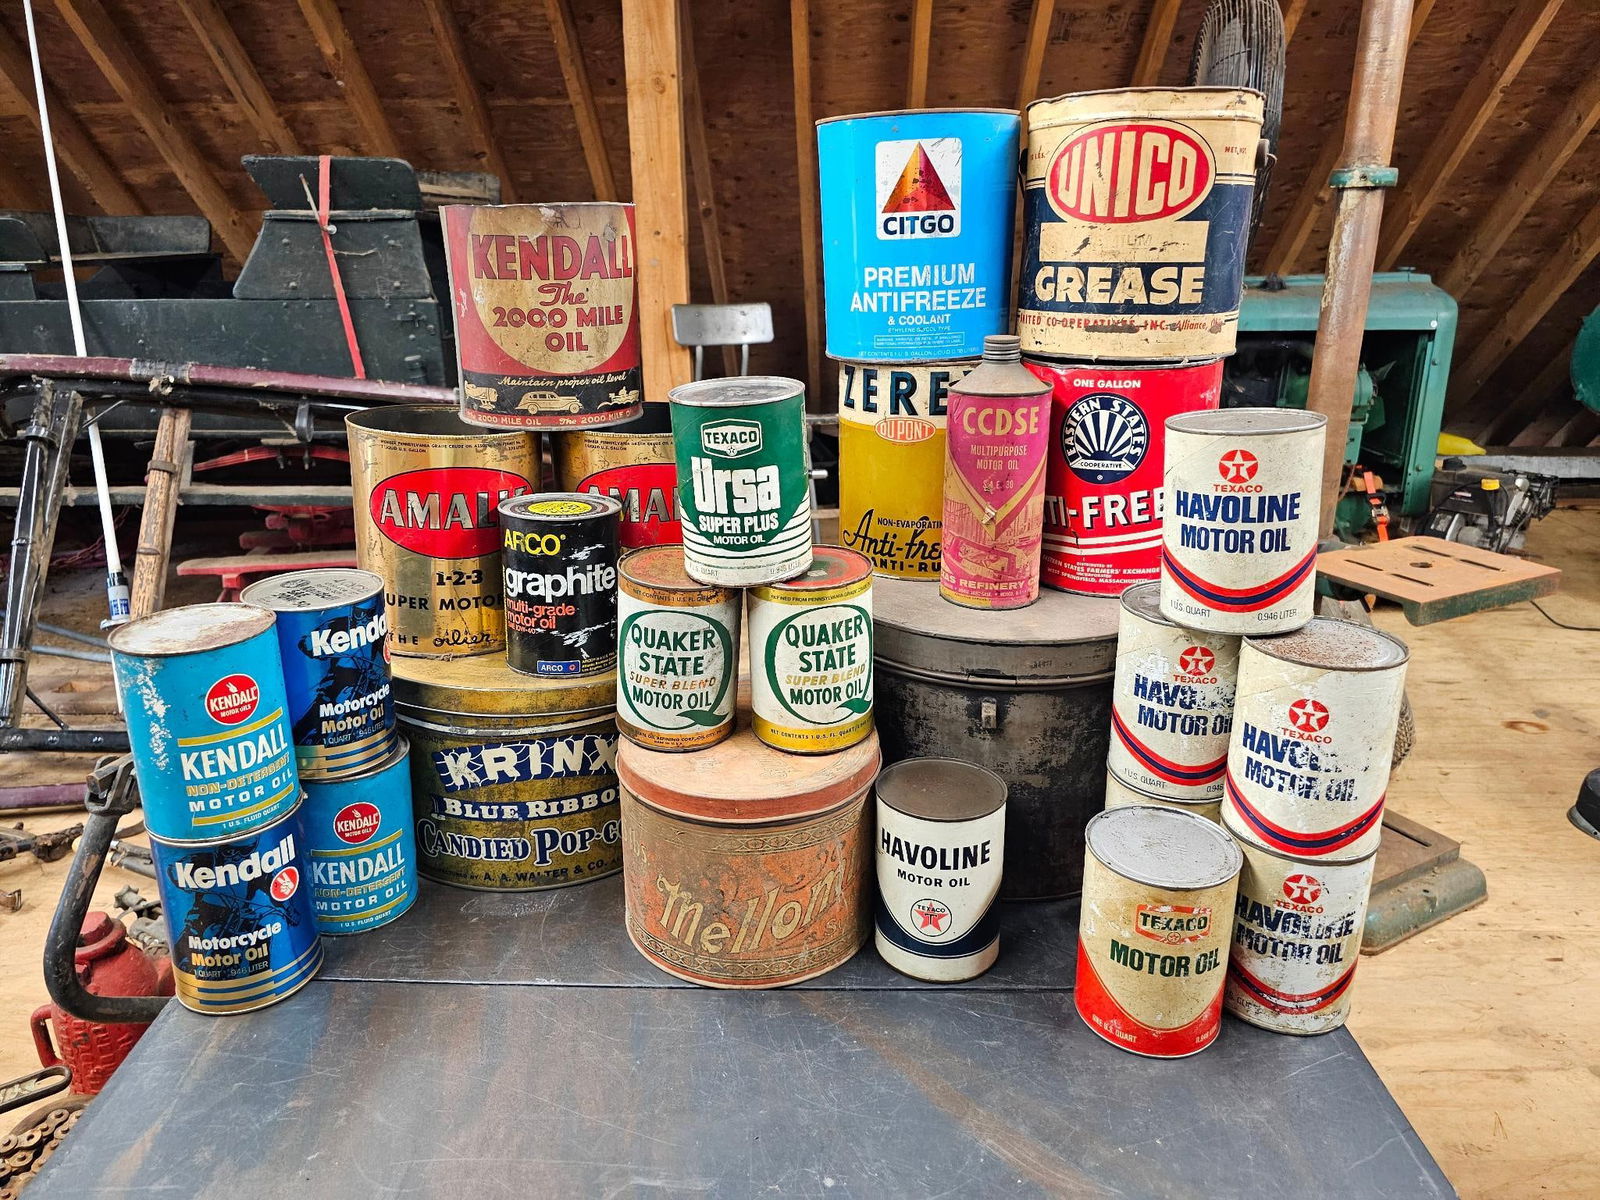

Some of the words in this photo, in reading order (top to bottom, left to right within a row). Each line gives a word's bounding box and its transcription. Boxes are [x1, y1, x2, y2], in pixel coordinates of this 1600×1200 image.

[1057, 131, 1198, 218] UNICO
[883, 214, 954, 236] CITGO
[471, 235, 633, 281] KENDALL
[864, 263, 975, 288] PREMIUM
[1034, 266, 1206, 305] GREASE
[538, 281, 588, 307] The
[850, 287, 986, 312] ANTIFREEZE
[493, 307, 568, 328] 2000
[577, 305, 623, 328] MILE
[888, 317, 896, 325] &
[898, 314, 951, 325] COOLANT
[545, 332, 589, 352] OIL
[498, 375, 556, 387] Maintain
[555, 377, 590, 389] proper
[591, 374, 605, 384] oil
[606, 371, 627, 383] level
[843, 365, 972, 416] ZERE
[1073, 379, 1094, 388] ONE
[1097, 379, 1141, 389] GALLON
[478, 414, 498, 424] 2000
[501, 416, 522, 426] MILE
[526, 417, 542, 426] OIL
[559, 417, 577, 426] The
[581, 414, 606, 425] 2000
[897, 420, 929, 440] PONT
[963, 406, 1039, 436] CCDSE
[1064, 397, 1101, 457] EASTERN
[1110, 399, 1145, 457] STATES
[705, 431, 757, 444] TEXACO
[970, 445, 1028, 457] MULTIPURPOSE
[976, 459, 1003, 470] MOTOR
[1008, 459, 1020, 470] OIL
[1080, 461, 1122, 469] COOPERATIVE
[691, 456, 781, 514] Ursa
[1213, 484, 1263, 493] TEXACO
[380, 484, 527, 530] AMAL
[1175, 490, 1301, 524] HAVOLINE
[698, 515, 740, 534] SUPER
[744, 512, 779, 533] PLUS
[713, 535, 748, 545] MOTOR
[750, 534, 766, 543] OIL
[1180, 524, 1254, 554] MOTOR
[1260, 527, 1291, 553] OIL
[436, 570, 483, 586] 1-2-3
[1064, 562, 1084, 572] STATES
[1086, 567, 1121, 575] FARMERS'
[1123, 567, 1160, 575] EXCHANGE
[505, 561, 616, 602] graphite
[960, 579, 1025, 590] REFINERY
[386, 593, 429, 610] UPER
[506, 597, 576, 618] multi-grade
[808, 593, 844, 602] PENNSYLVANIA
[507, 611, 537, 627] motor
[540, 616, 556, 629] oil
[1185, 604, 1211, 618] QUART
[1257, 612, 1278, 621] 0.946
[1279, 608, 1298, 620] LITER
[389, 632, 419, 645] THE
[631, 623, 717, 651] QUAKER
[785, 614, 864, 648] QUAKER
[540, 664, 563, 672] ARCO
[639, 652, 704, 676] STATE
[800, 643, 856, 673] STATE
[630, 671, 666, 690] SUPER
[672, 677, 716, 691] BLEND
[785, 673, 827, 686] SUPER
[831, 664, 866, 682] BLEND
[1173, 674, 1218, 684] TEXACO
[210, 686, 257, 712] KENDALL
[320, 683, 390, 717] Motorcycle
[632, 686, 683, 710] MOTOR
[687, 691, 712, 709] OIL
[790, 686, 842, 705] MOTOR
[845, 678, 864, 699] OIL
[220, 709, 240, 718] MOTOR
[239, 704, 252, 713] OILS
[322, 711, 368, 734] Motor
[370, 703, 384, 720] Oil
[1137, 704, 1209, 736] MOTOR
[328, 733, 352, 745] QUART
[781, 731, 809, 740] CONTENTS
[1281, 727, 1333, 744] TEXACO
[180, 723, 288, 782] KENDALL
[443, 738, 617, 787] KRINX
[186, 751, 290, 798] NON-DETERGENT
[1140, 775, 1167, 789] QUART
[189, 785, 265, 813] MOTOR
[272, 768, 293, 790] OIL
[443, 797, 520, 820] BLUE
[526, 787, 619, 818] RIBBO
[228, 818, 242, 828] U.S.
[243, 812, 262, 824] FLUID
[263, 803, 281, 816] QUART
[337, 813, 379, 833] KENDALL
[362, 827, 372, 835] OILS
[416, 817, 531, 862] CANDIED
[882, 827, 991, 870] HAVOLINE
[175, 833, 297, 889] Kendall
[312, 842, 405, 885] KENDALL
[516, 867, 568, 882] WALTER
[573, 865, 583, 874] &
[588, 859, 608, 870] CO.
[314, 865, 406, 898] NON-DETERGENT
[897, 868, 943, 887] MOTOR
[949, 877, 971, 888] OIL
[316, 893, 378, 911] MOTOR
[385, 879, 407, 898] OIL
[917, 904, 946, 913] TEXACO
[1275, 899, 1324, 914] TEXACO
[357, 916, 373, 926] FLUID
[374, 910, 392, 921] QUART
[1139, 912, 1208, 931] TEXACO
[188, 921, 282, 950] Motorcycle
[1236, 922, 1312, 960] MOTOR
[1316, 943, 1343, 964] OIL
[191, 952, 241, 967] Motor
[244, 942, 269, 962] Oil
[1109, 939, 1190, 977] MOTOR
[1195, 947, 1221, 976] OIL
[199, 970, 221, 978] QUART
[248, 960, 269, 973] LITER
[1115, 1029, 1138, 1043] QUART
